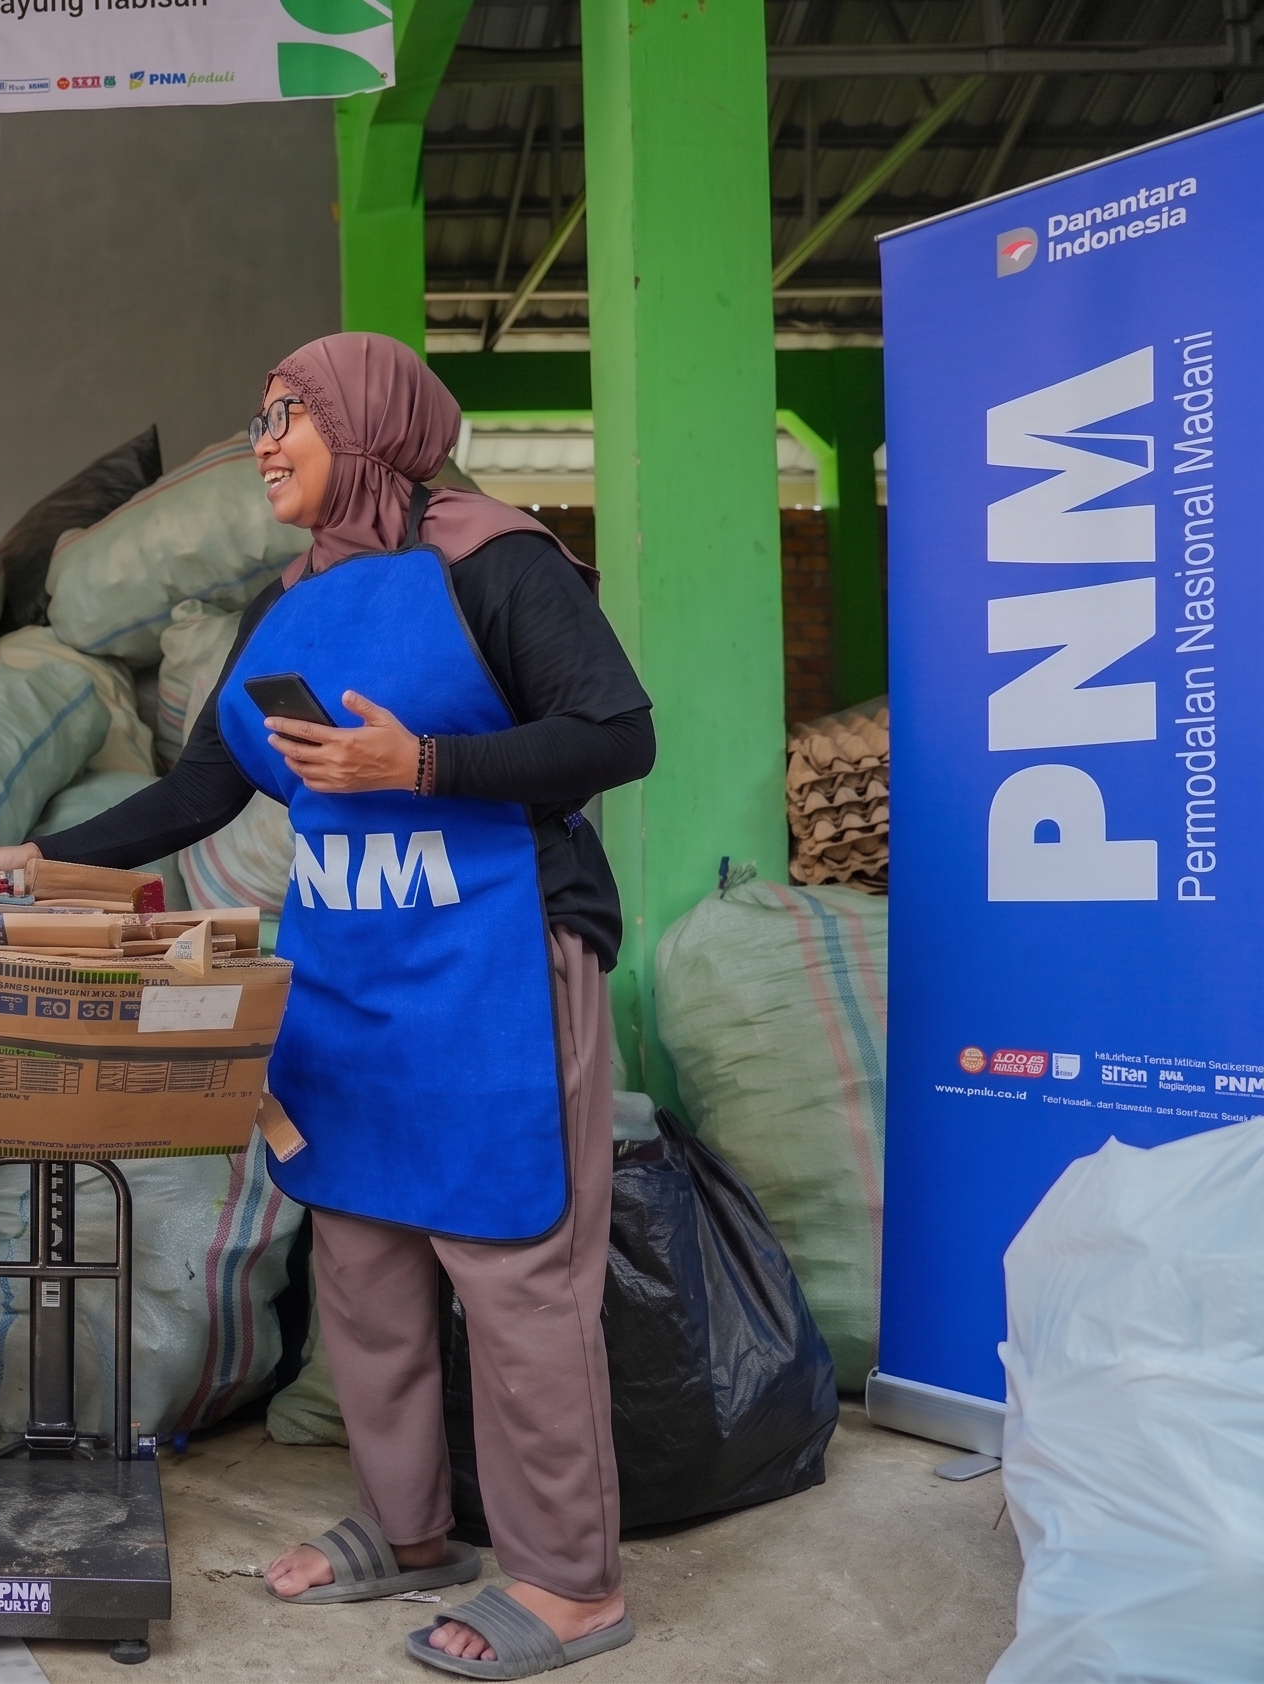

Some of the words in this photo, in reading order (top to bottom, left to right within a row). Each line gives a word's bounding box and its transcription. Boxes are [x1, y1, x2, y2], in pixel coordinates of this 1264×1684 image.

[149, 73, 186, 85] PNM
[187, 71, 235, 88] peduli
[1048, 177, 1197, 238] Danantara
[1048, 207, 1187, 263] Indonesia
[1172, 330, 1214, 475] Madani
[1173, 484, 1216, 654] Nasional
[987, 345, 1158, 902] PNM
[1174, 666, 1217, 902] Permodalan
[290, 830, 461, 910] NM
[1214, 1075, 1264, 1093] PNM
